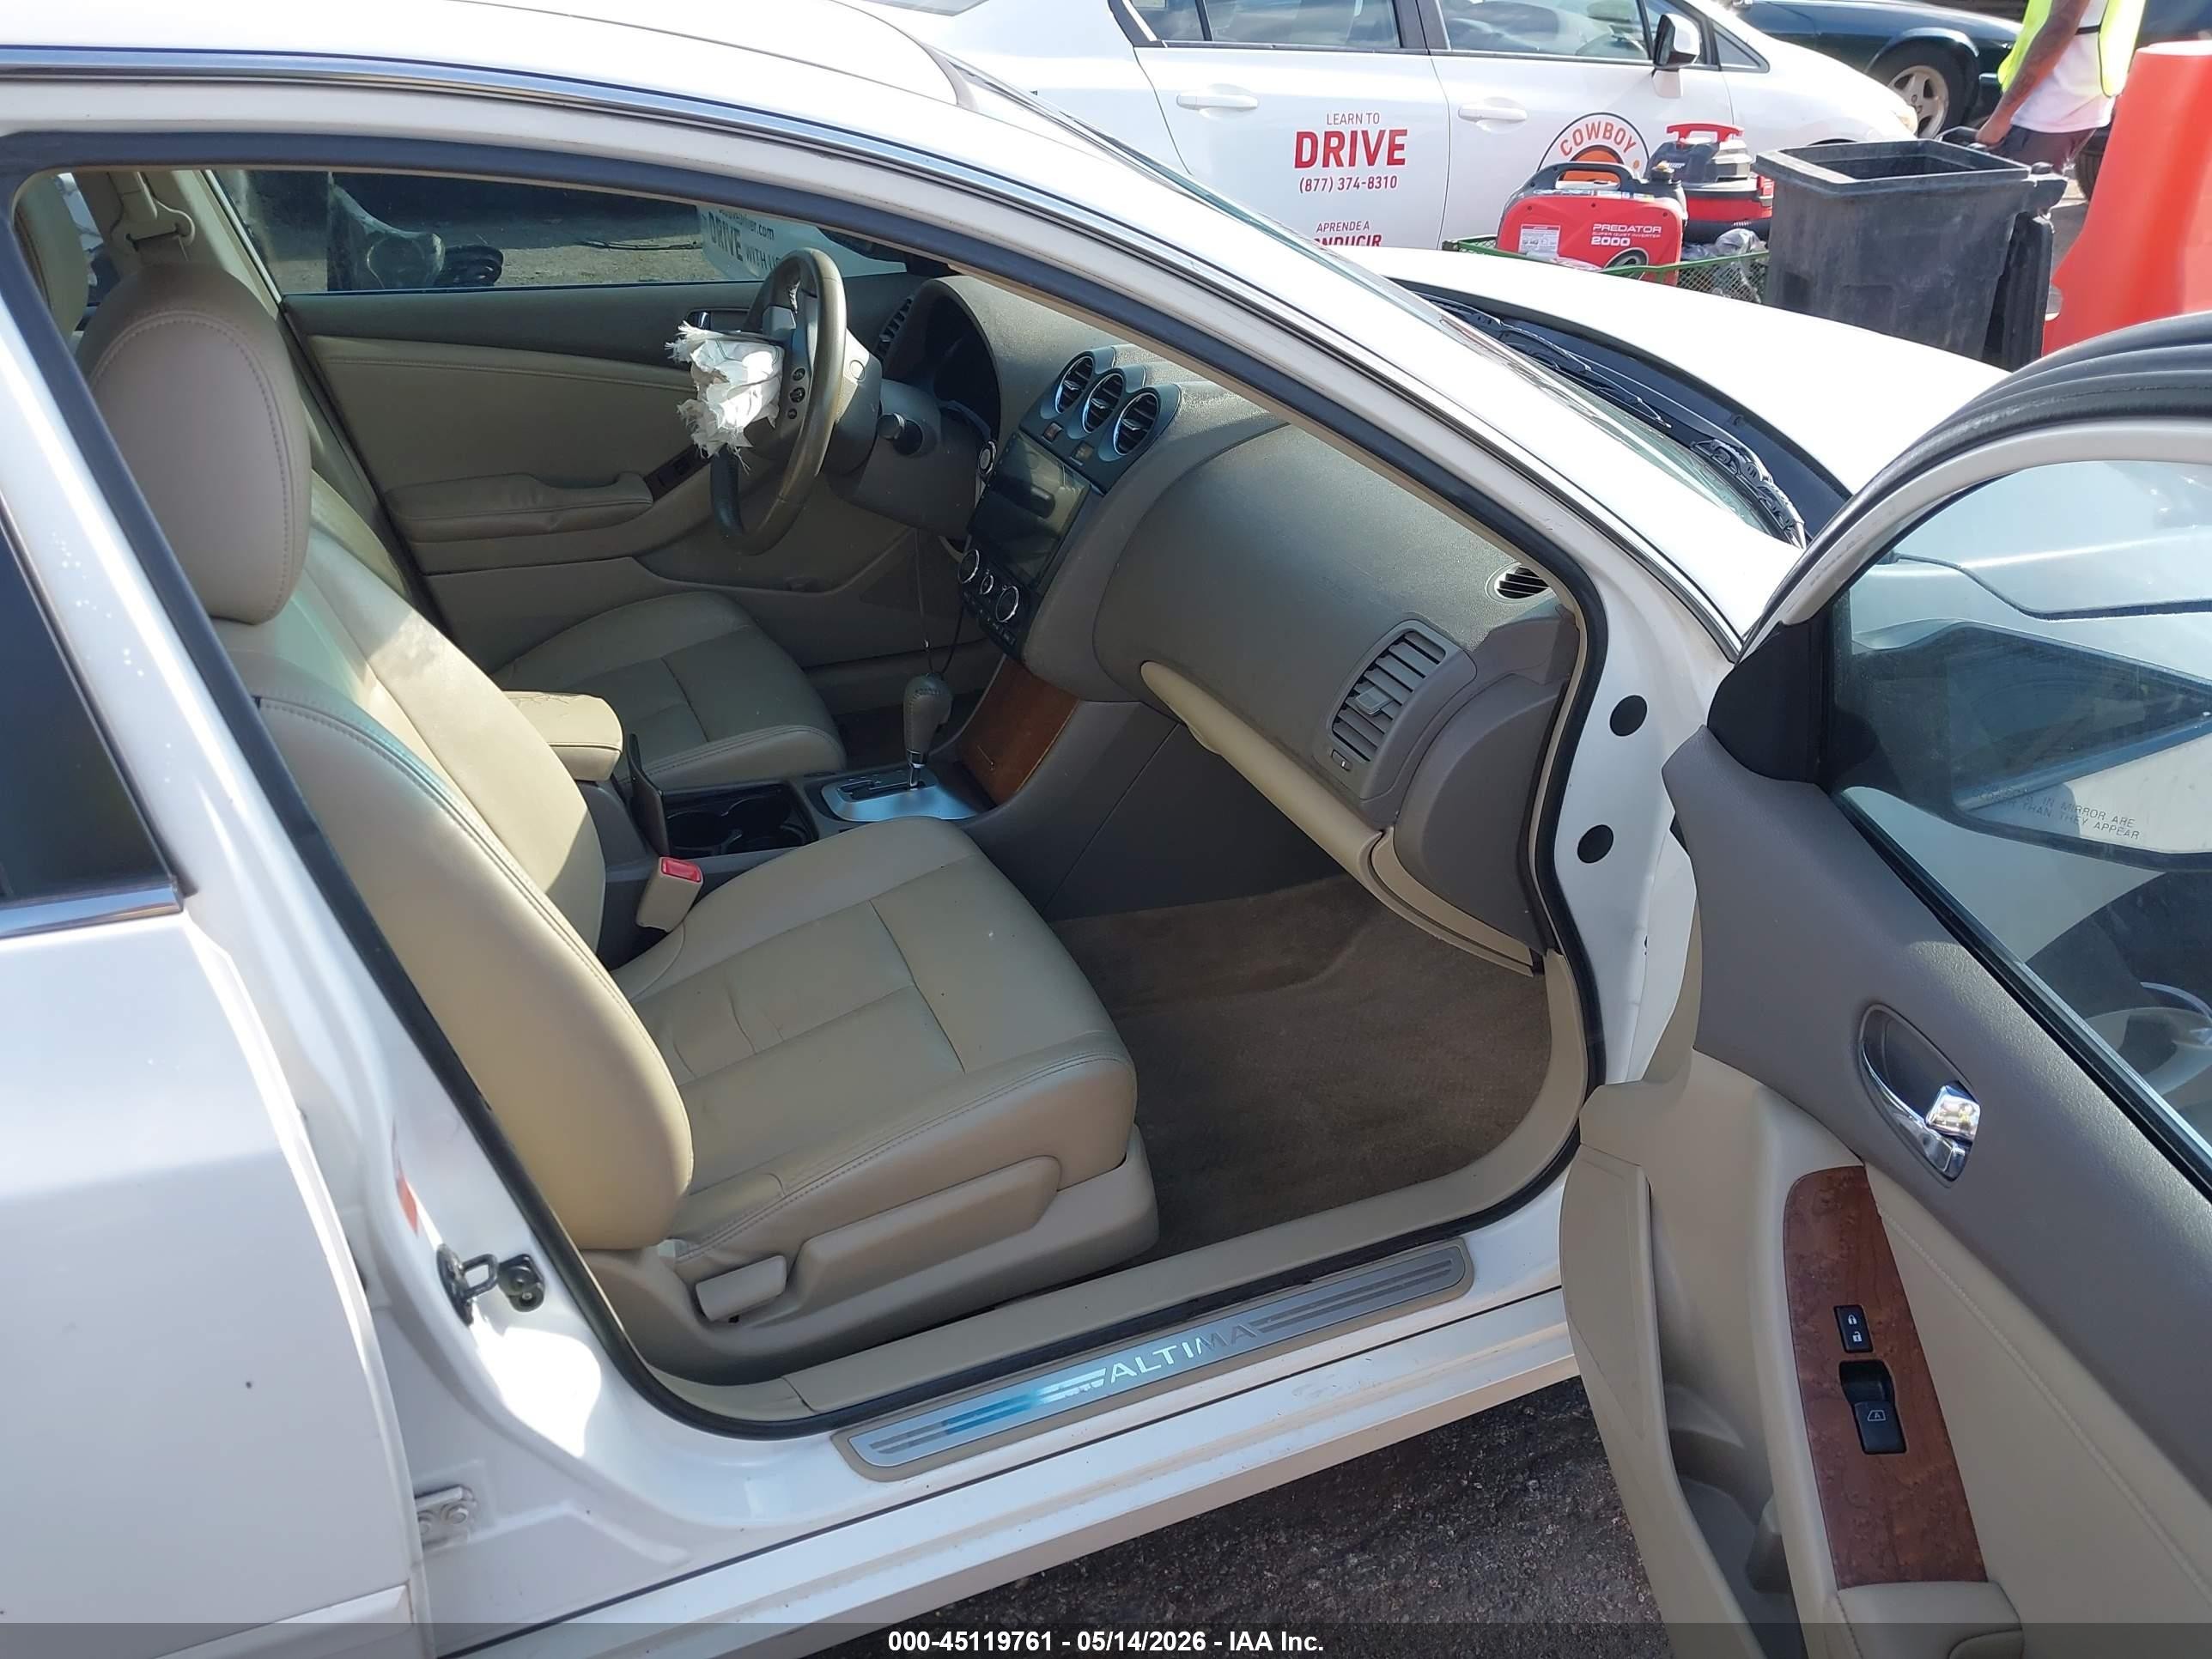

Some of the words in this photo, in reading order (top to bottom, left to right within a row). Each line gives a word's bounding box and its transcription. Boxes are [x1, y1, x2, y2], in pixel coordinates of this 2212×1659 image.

[1327, 113, 1363, 125] LEARN
[1366, 112, 1380, 125] TO
[1559, 121, 1637, 156] COWBOY
[1294, 129, 1408, 169] DRIVE
[1299, 177, 1334, 193] (877)
[1338, 175, 1398, 191] 374-8310
[1316, 222, 1362, 233] APRENDE
[1363, 221, 1370, 231] A
[1593, 223, 1662, 234] PREDATOR
[1591, 236, 1631, 246] 2000
[2061, 801, 2106, 821] MIRROR
[2112, 815, 2136, 828] ARE
[2094, 821, 2141, 840] APPEAR
[1110, 1325, 1258, 1385] ALTIMA
